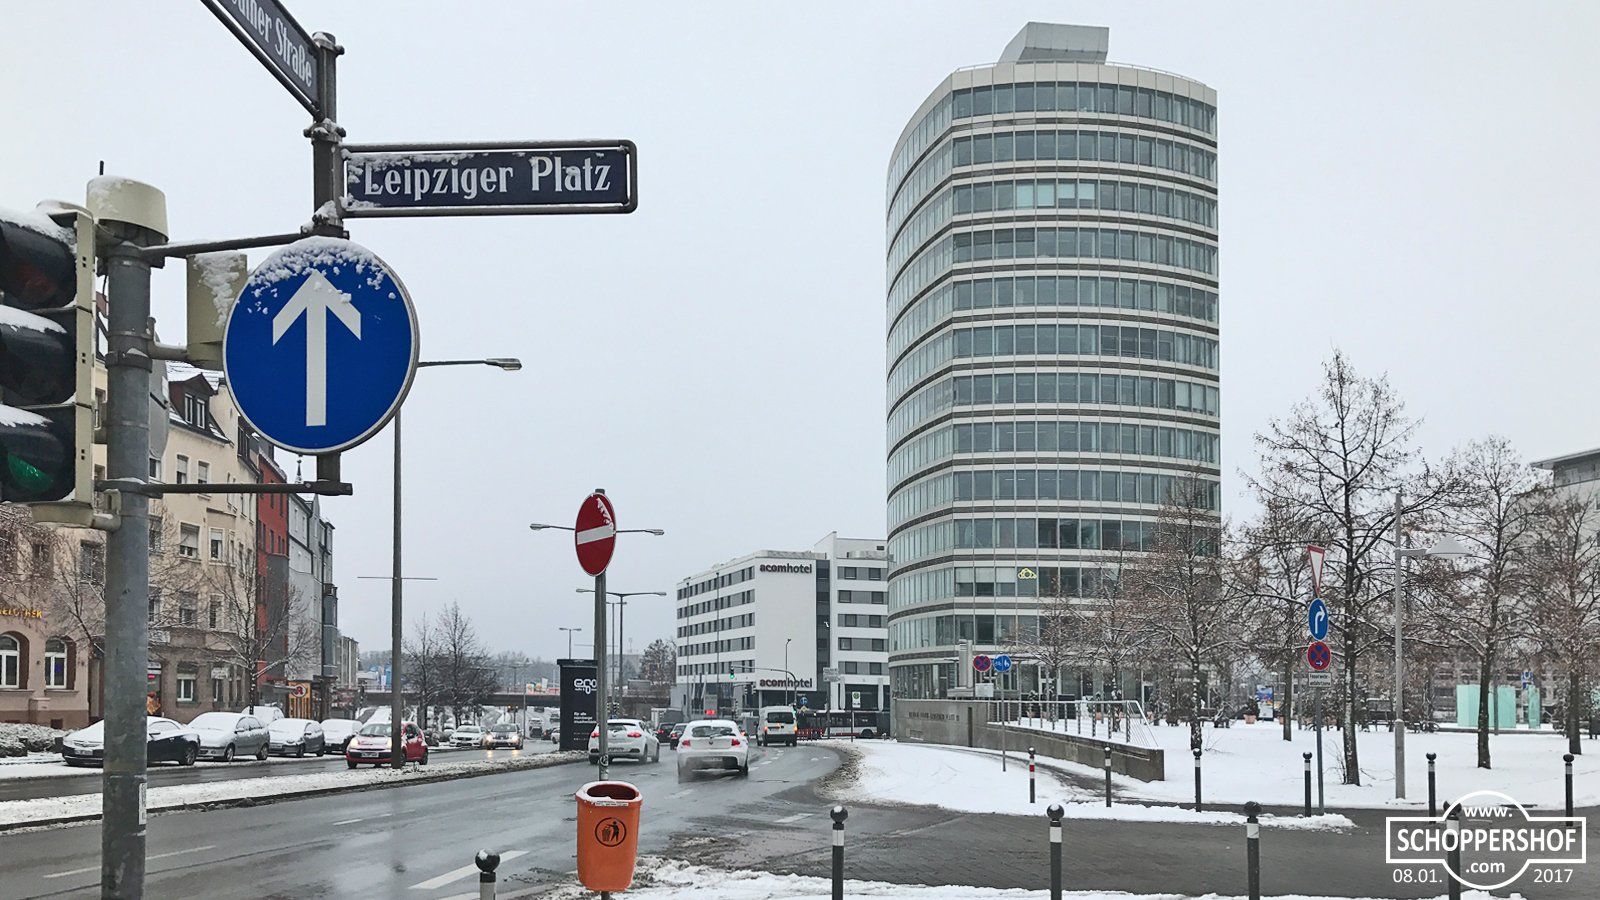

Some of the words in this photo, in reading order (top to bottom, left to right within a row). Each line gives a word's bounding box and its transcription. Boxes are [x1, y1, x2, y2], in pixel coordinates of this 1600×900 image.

[275, 17, 312, 88] Straße
[364, 158, 513, 202] Leipziger
[530, 157, 611, 192] Platz
[759, 563, 812, 574] acomhotel
[759, 678, 813, 688] acomhotel
